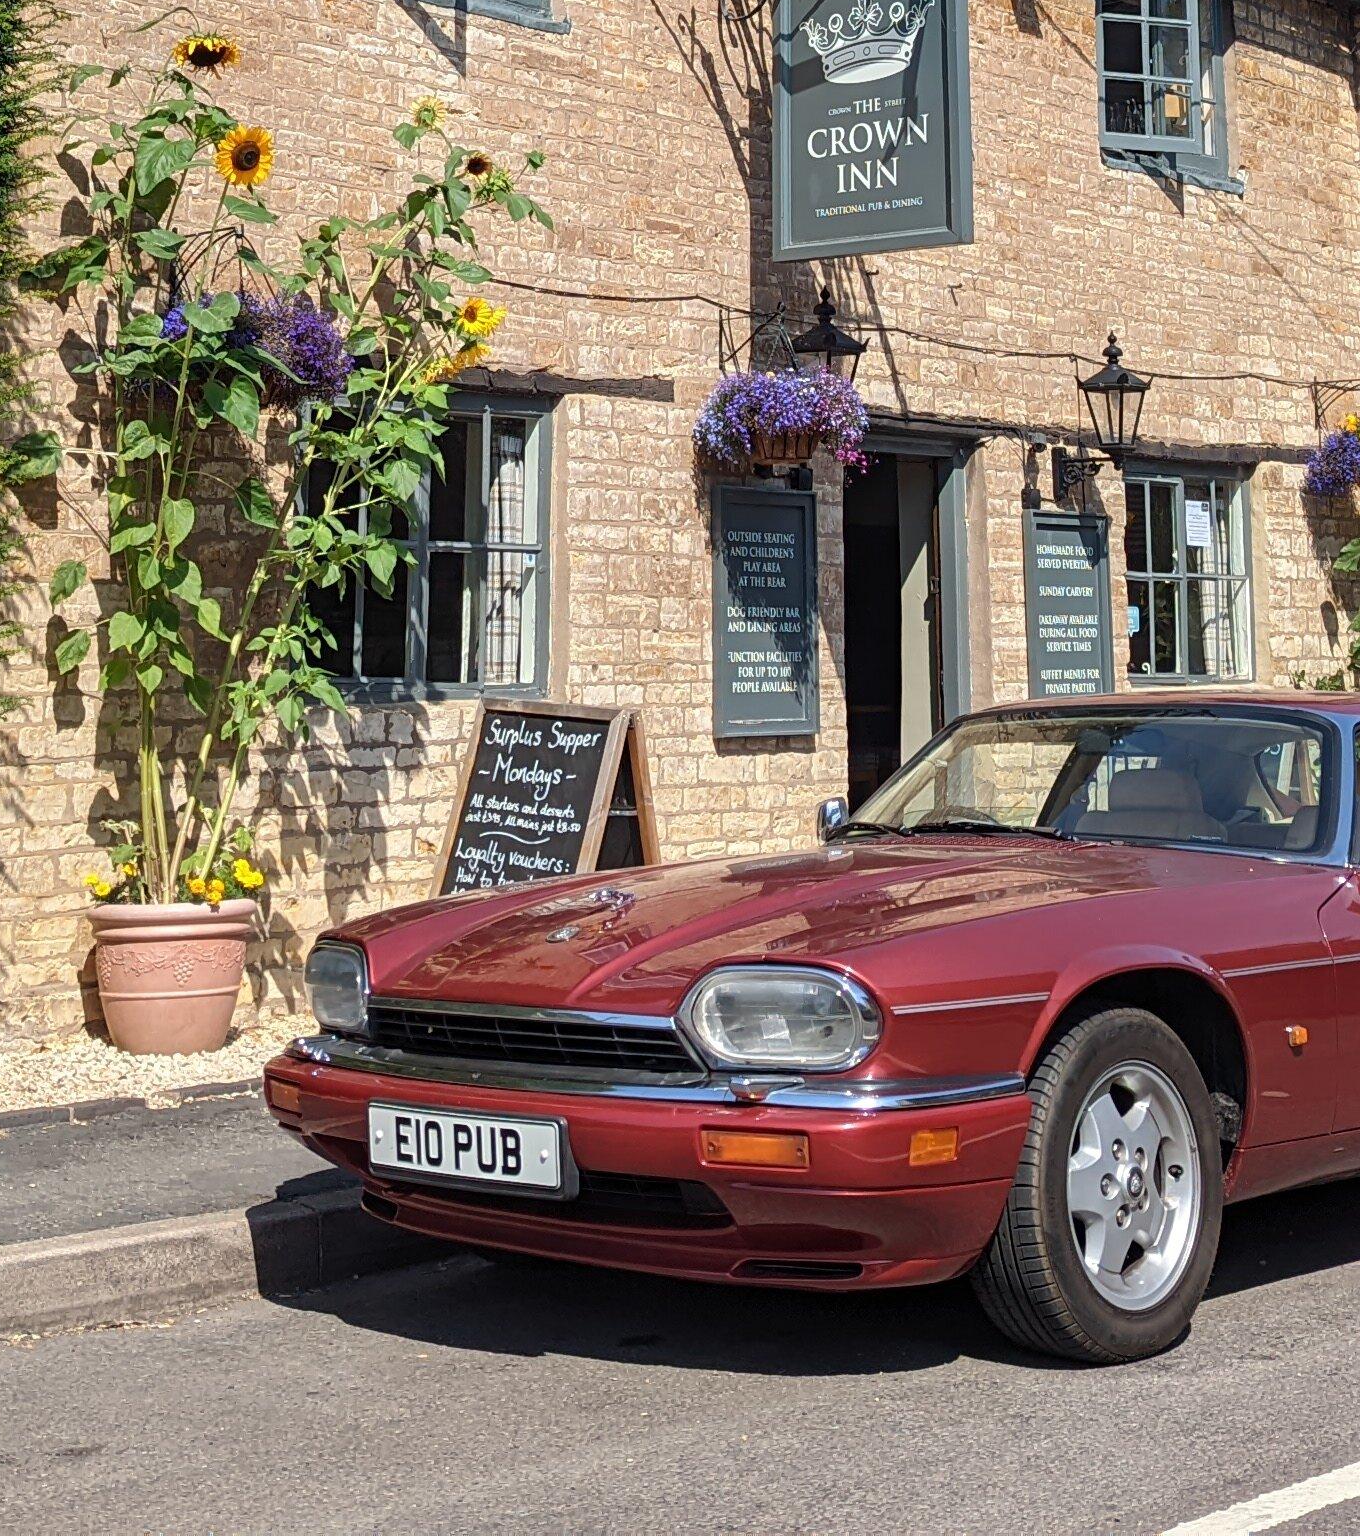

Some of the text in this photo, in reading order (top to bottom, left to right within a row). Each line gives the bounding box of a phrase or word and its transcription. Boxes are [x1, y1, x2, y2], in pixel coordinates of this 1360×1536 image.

[853, 97, 882, 114] THE
[807, 113, 929, 159] CROWN
[837, 156, 900, 194] INN
[815, 196, 923, 218] TRADITIONAL PUB & DINING
[727, 530, 795, 544] OUTSIDE SEATING
[730, 546, 794, 559] AND CHILDREN'S
[1036, 544, 1094, 556] HOMEMADE FOOD
[743, 561, 781, 573] PLAY AREA
[1037, 558, 1061, 569] SERVED
[739, 576, 786, 588] AT THE REAR
[1039, 585, 1094, 597] SUNDAY CARVERY
[727, 606, 801, 618] DOG FRIENDLY BAR
[1068, 614, 1098, 625] AVAILABLE
[727, 621, 801, 633] AND DINING AREAS
[1039, 627, 1098, 638] DURING ALL FOOD
[1046, 641, 1092, 652] SERVICE TIMES
[766, 651, 802, 663] FACILITIES
[738, 666, 792, 678] FOR UP TO 100
[1063, 669, 1086, 680] MENUS
[1086, 668, 1101, 679] FOR
[732, 680, 798, 693] PEOPLE AVAILABLE
[1045, 682, 1096, 694] PRIVATE PARTIES
[484, 718, 602, 755] Surplus Supper
[469, 792, 575, 818] All starters and desserts
[464, 809, 480, 823] just
[504, 814, 516, 827] All
[517, 817, 539, 831] mains
[538, 819, 554, 835] just
[455, 837, 505, 873] Loyalty
[456, 866, 476, 884] How
[480, 870, 492, 888] to
[395, 1116, 522, 1176] E10 PUB
